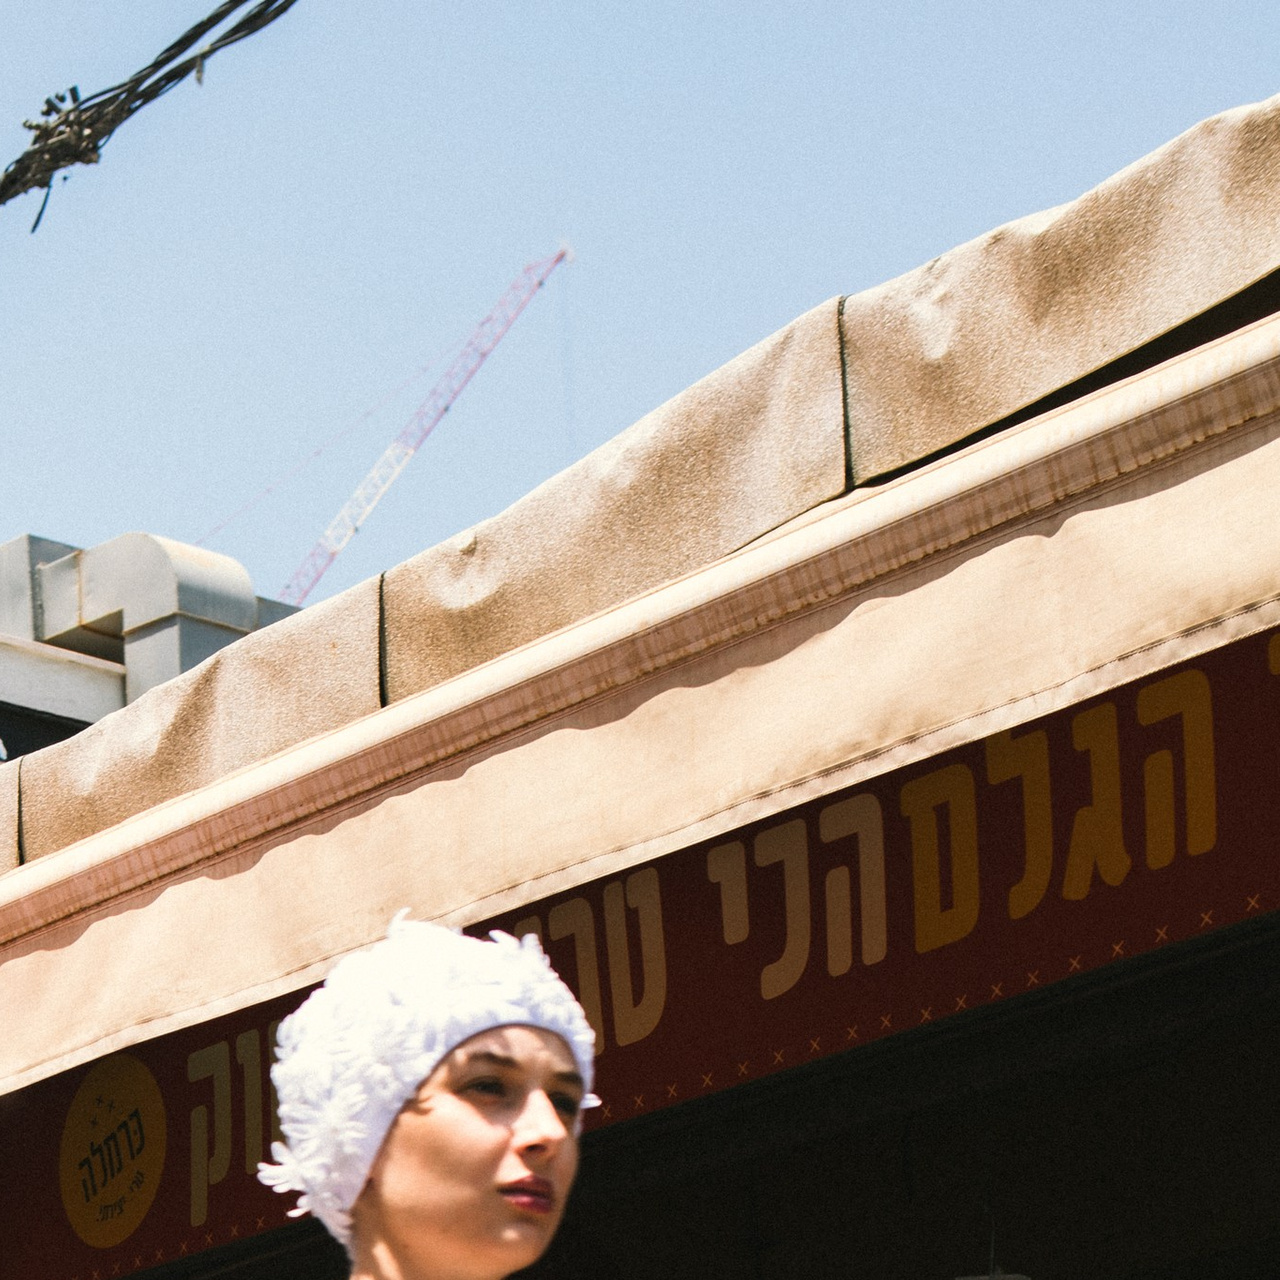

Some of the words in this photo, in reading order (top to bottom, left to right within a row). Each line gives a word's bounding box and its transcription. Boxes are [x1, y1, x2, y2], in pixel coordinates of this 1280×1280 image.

[707, 793, 888, 1001] הכי
[900, 669, 1218, 955] הגלם
[513, 866, 667, 1058] טר
[78, 1108, 145, 1203] כרמלה
[187, 1019, 282, 1228] וק
